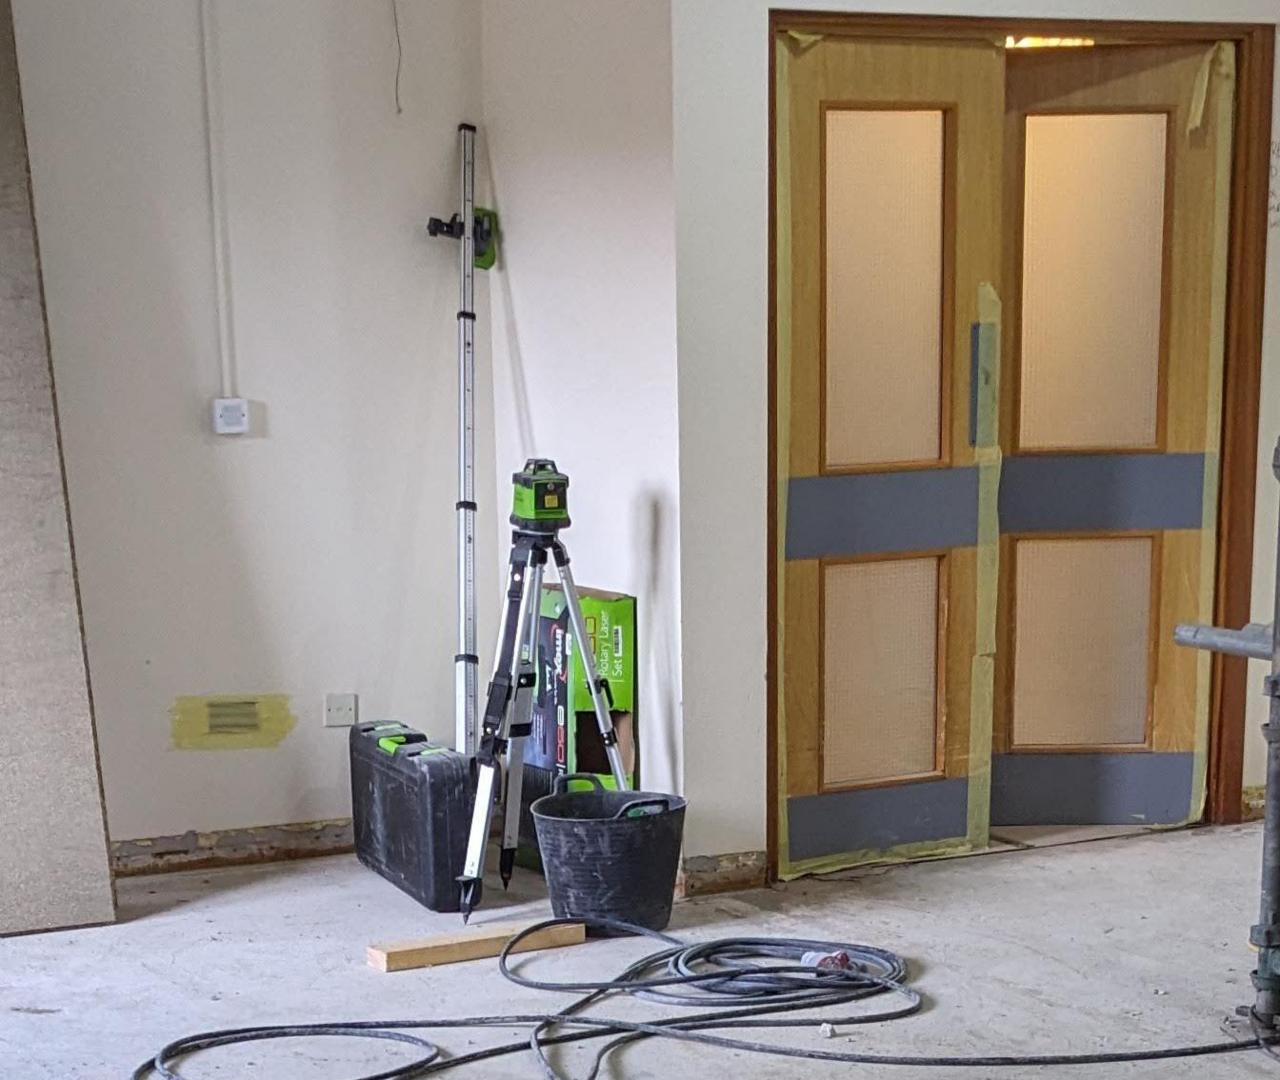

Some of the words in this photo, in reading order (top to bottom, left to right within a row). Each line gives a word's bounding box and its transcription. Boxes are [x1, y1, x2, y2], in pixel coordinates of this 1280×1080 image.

[599, 610, 609, 638] Laser
[599, 642, 611, 676] Rotary
[612, 658, 623, 677] Set
